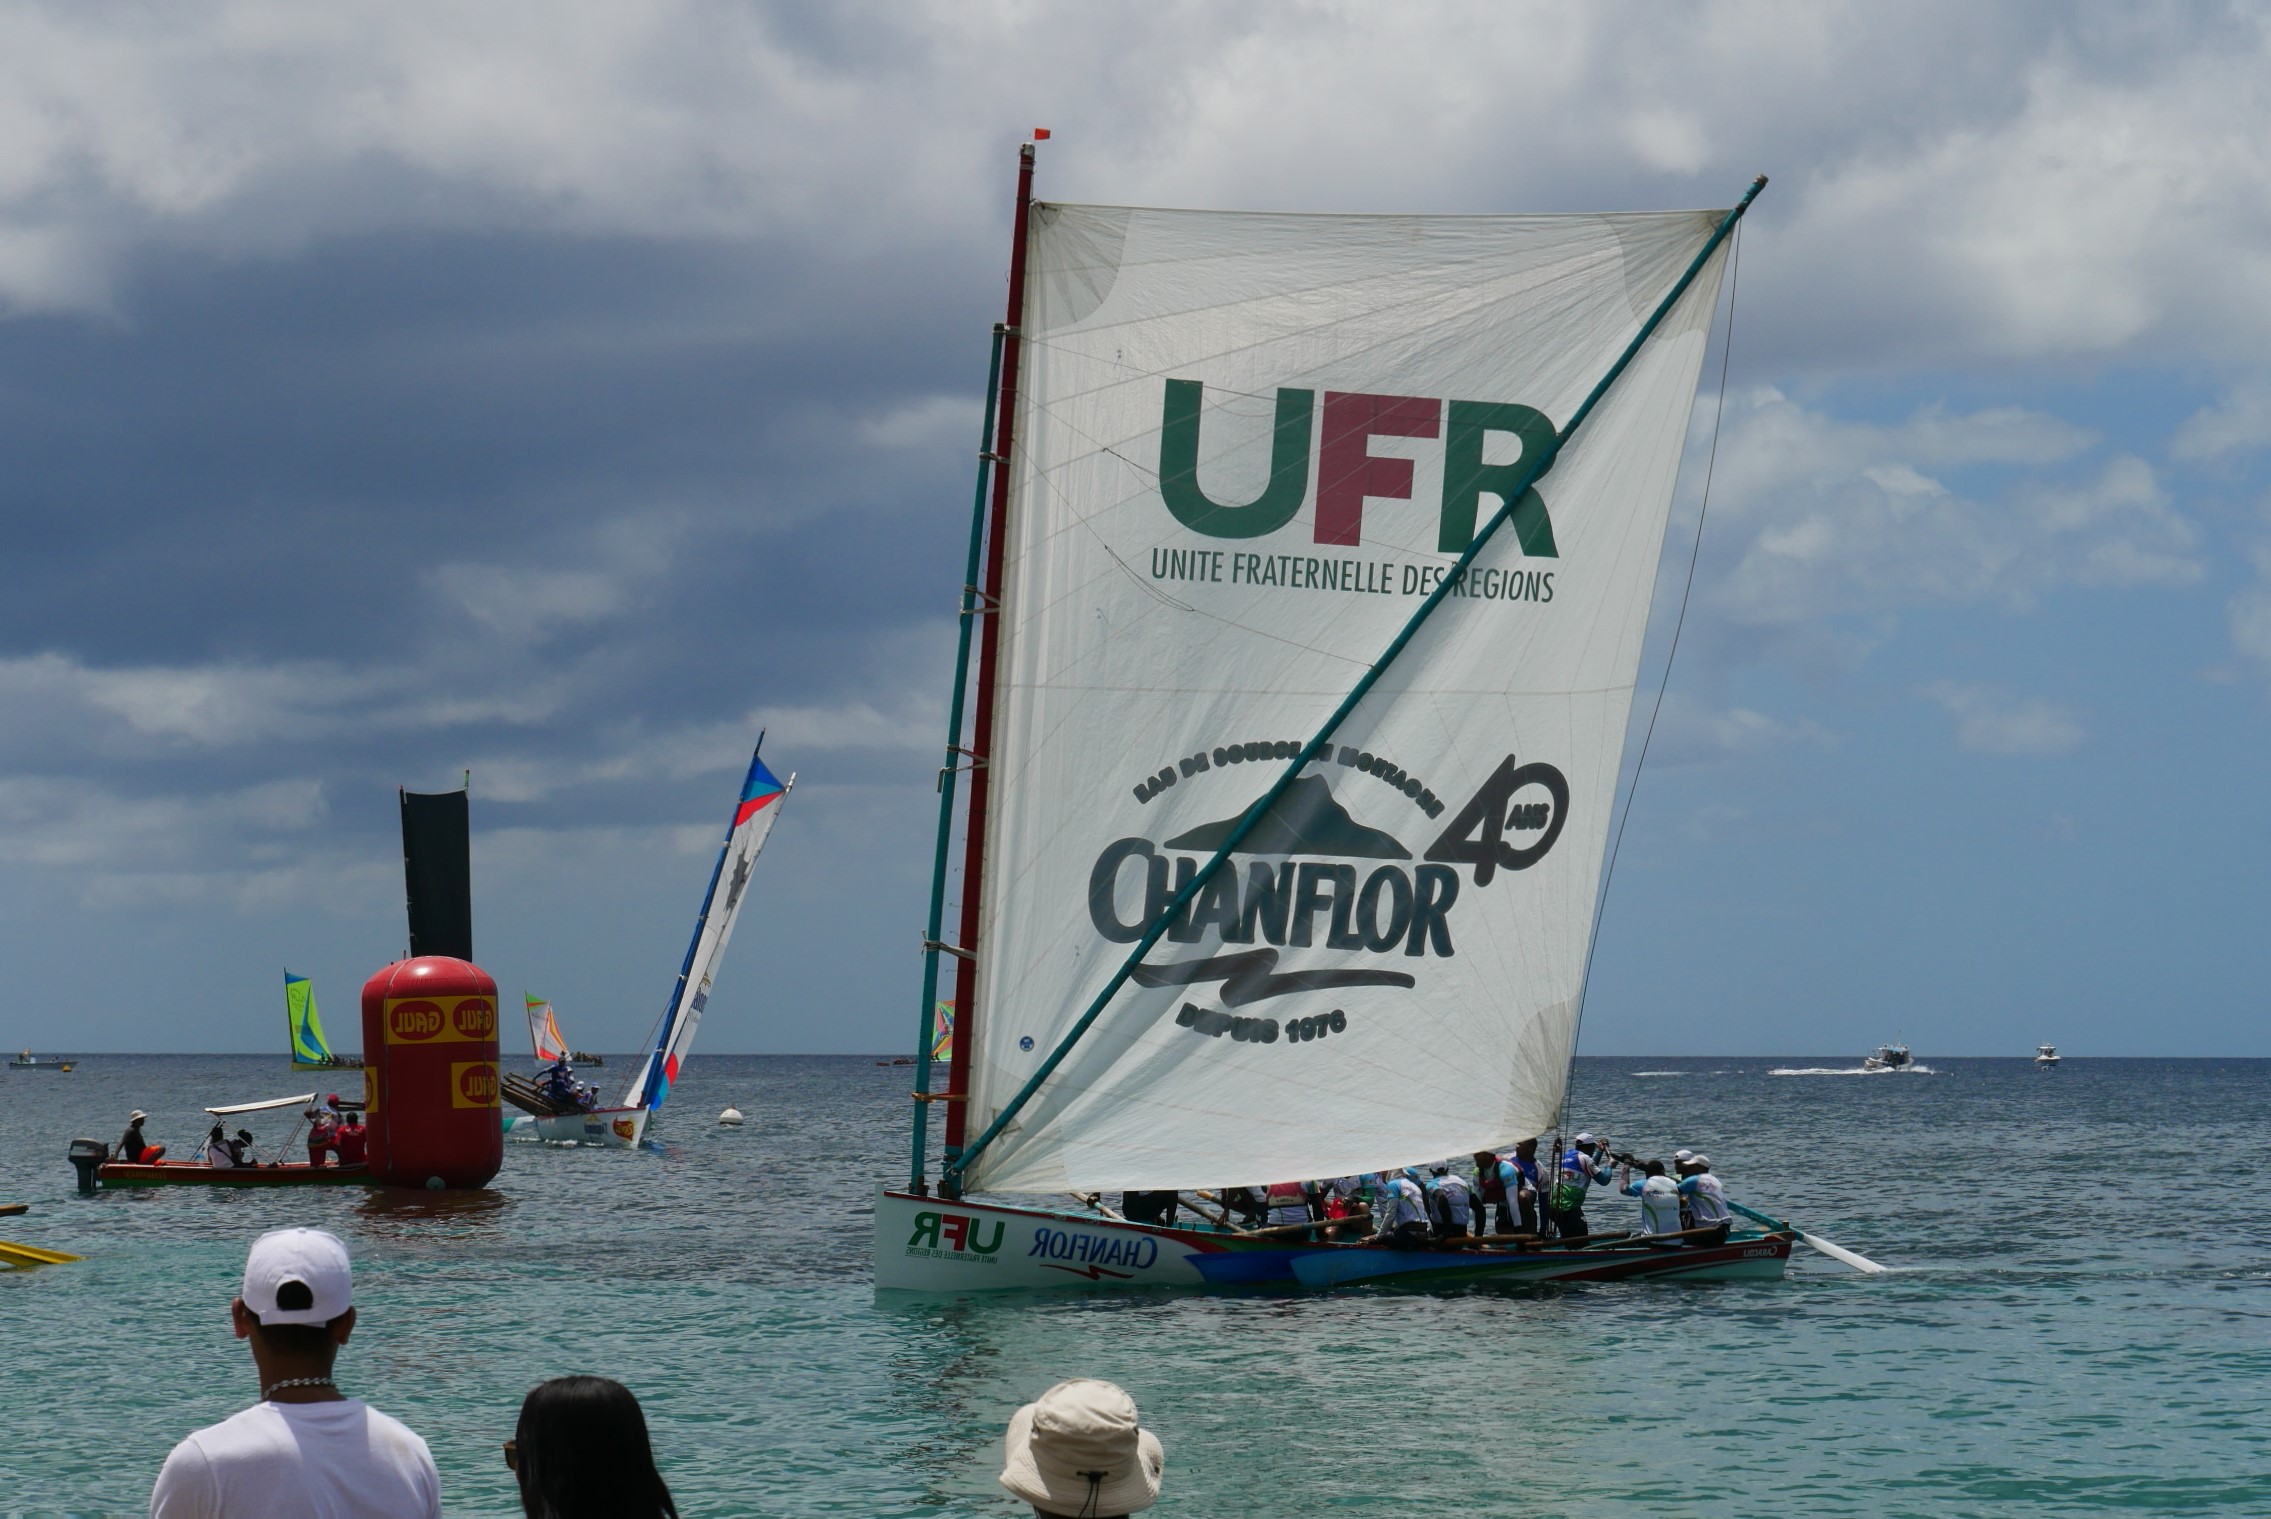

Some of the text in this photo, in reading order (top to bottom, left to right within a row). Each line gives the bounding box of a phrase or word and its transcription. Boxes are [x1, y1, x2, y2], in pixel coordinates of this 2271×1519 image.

[1159, 378, 1560, 558] UFR
[1152, 547, 1555, 603] UNITE FRATERNELLE DES REGIONS
[1423, 754, 1570, 888] 40 ANS
[1088, 837, 1460, 958] CHANFLOR
